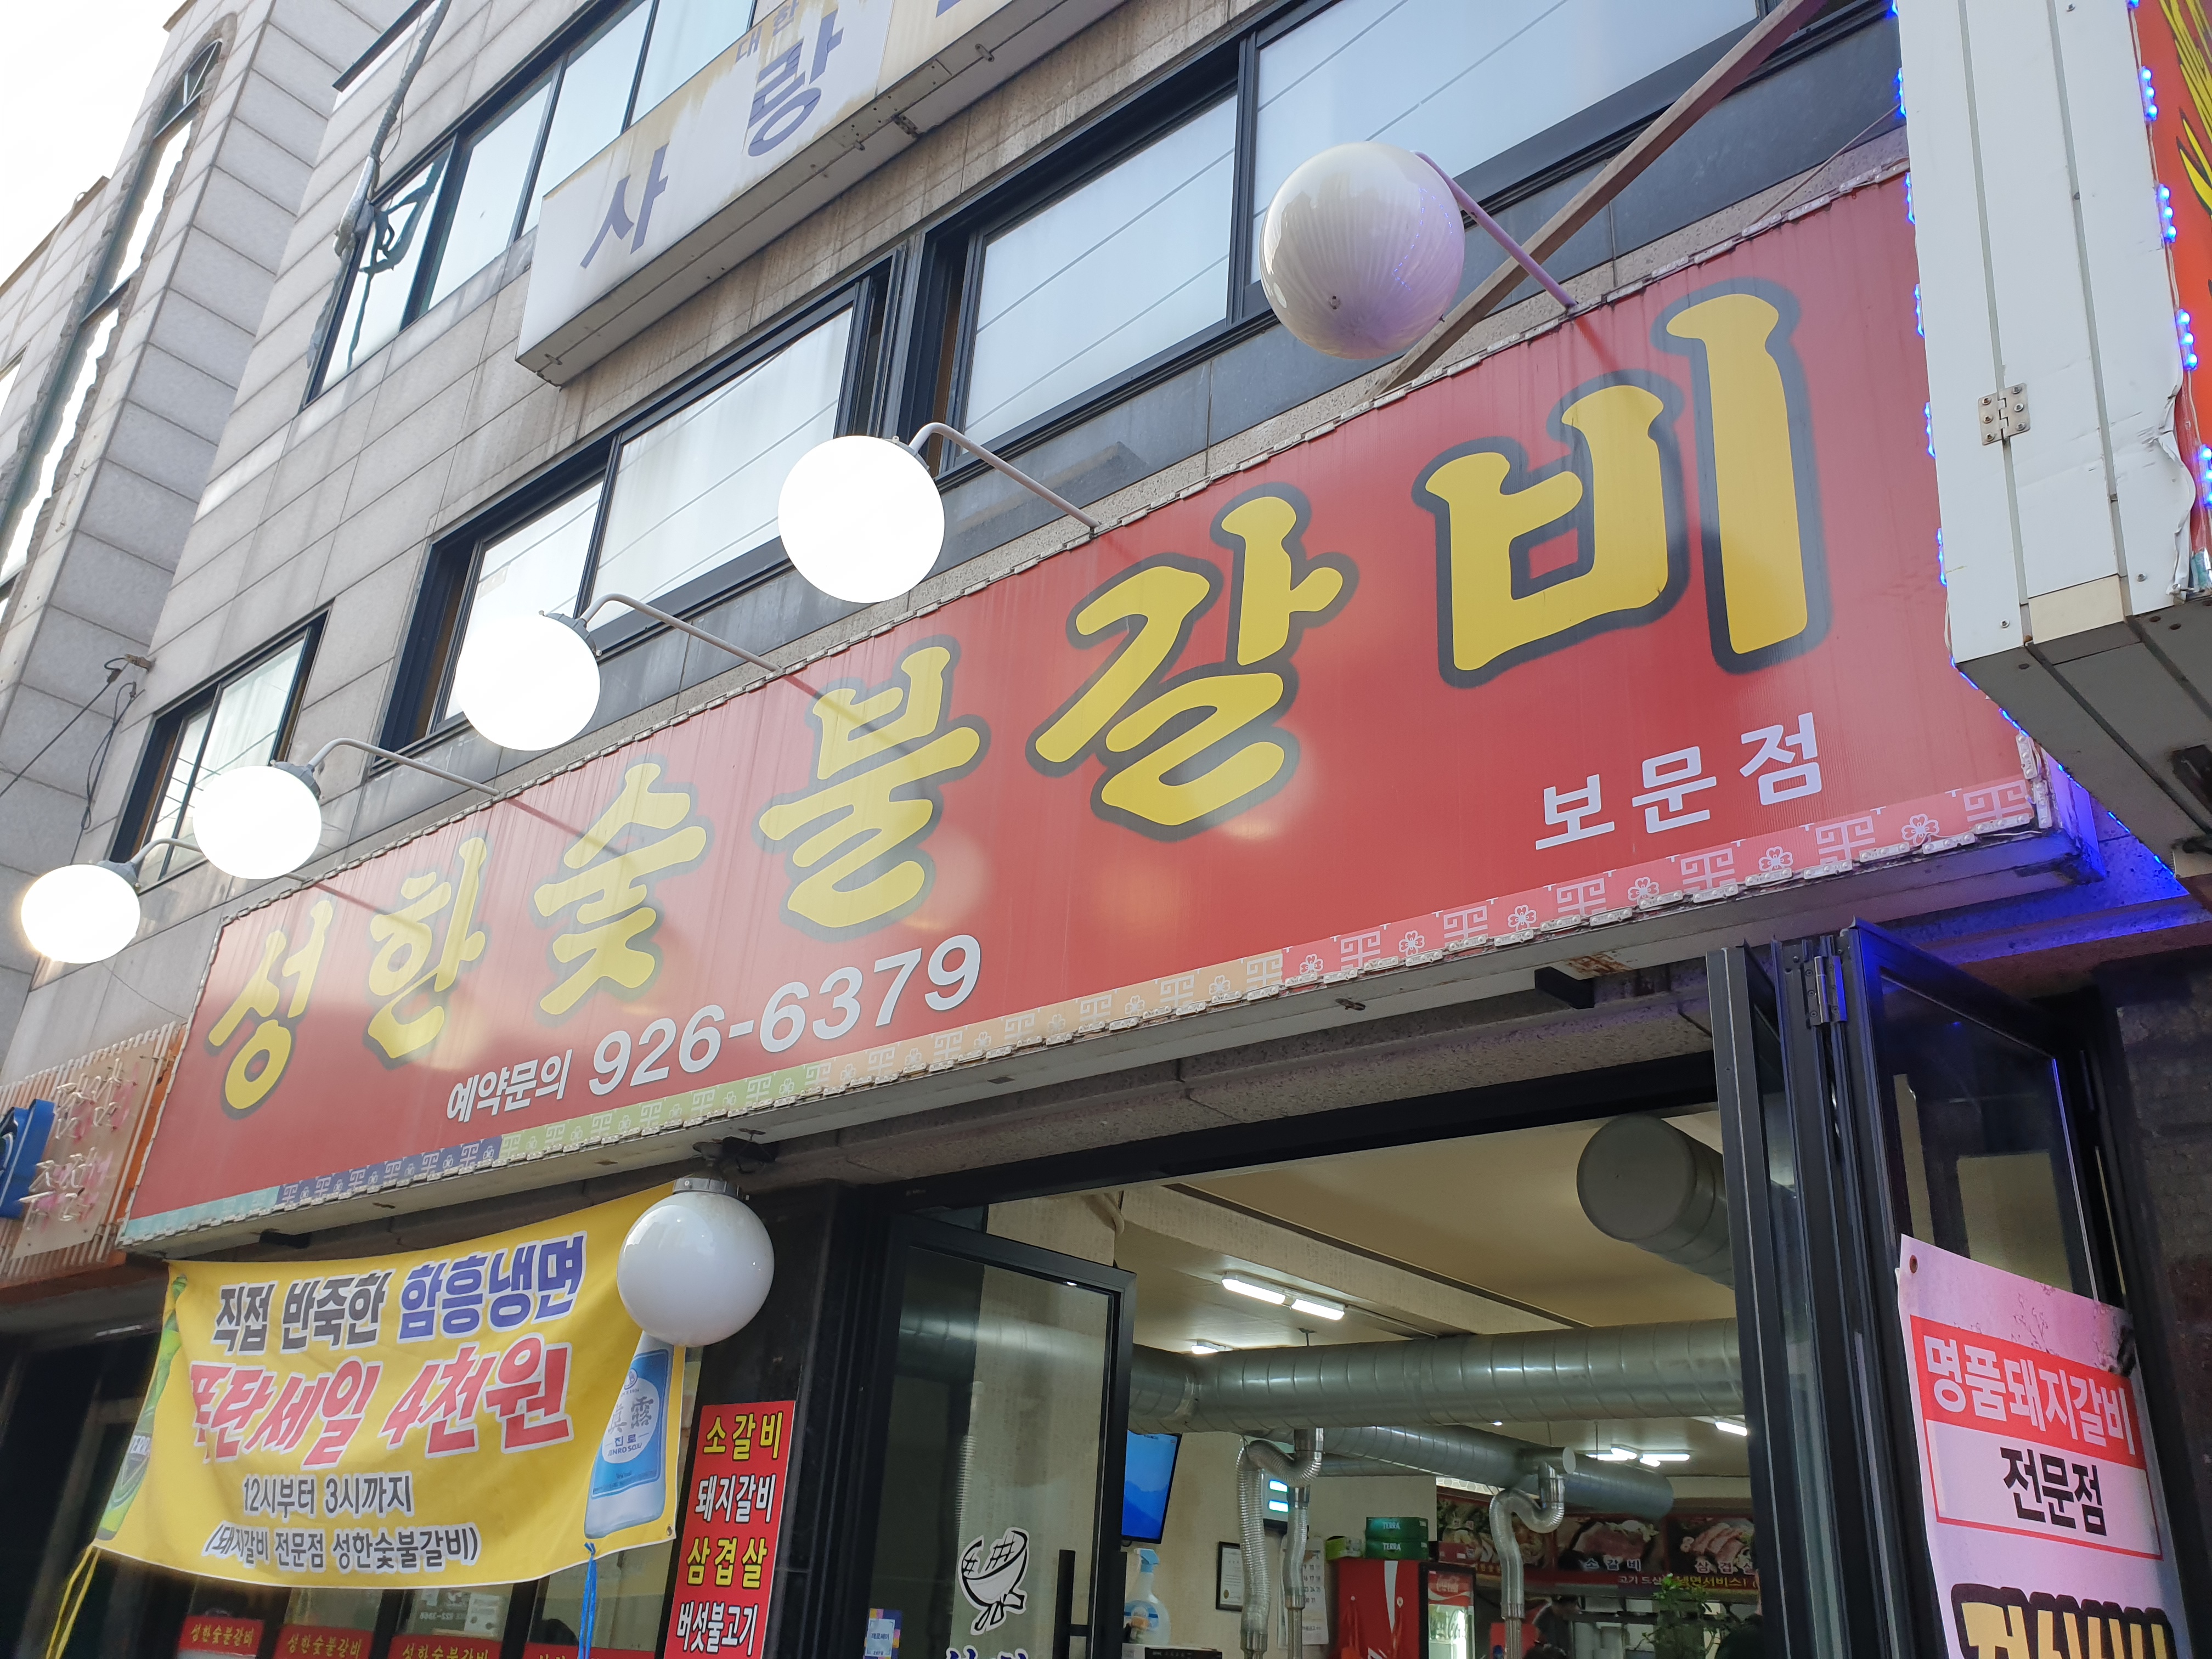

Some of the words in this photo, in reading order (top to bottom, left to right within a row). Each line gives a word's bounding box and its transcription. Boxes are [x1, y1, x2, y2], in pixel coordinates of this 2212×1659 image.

[207, 292, 1808, 1110] 성한숯불갈비
[1536, 712, 1822, 850] 보문점
[445, 1048, 573, 1124] 예약문의
[588, 934, 981, 1097] 926-6379
[215, 1283, 276, 1352] 직접
[281, 1271, 393, 1351] 반죽한
[399, 1234, 585, 1340] 함흥냉면
[380, 1337, 569, 1454] 4천원
[1923, 1334, 2136, 1456] 명품돼지갈비
[702, 1412, 783, 1460] 소갈비
[243, 1477, 315, 1519] 12시부터
[325, 1475, 413, 1515] 3시까지
[695, 1474, 776, 1523] 돼지갈비
[1999, 1446, 2107, 1537] 전문점
[275, 1532, 324, 1568] 전문점
[332, 1527, 478, 1570] 성한숯불갈비)
[1383, 1521, 1401, 1530] TERRA
[1383, 1542, 1401, 1551] TERRA
[686, 1537, 768, 1589] 삼겹살
[190, 1623, 255, 1647] 성한숯불갈비
[287, 1633, 363, 1656] 성한숯불갈비
[676, 1600, 759, 1657] 버섯불고기
